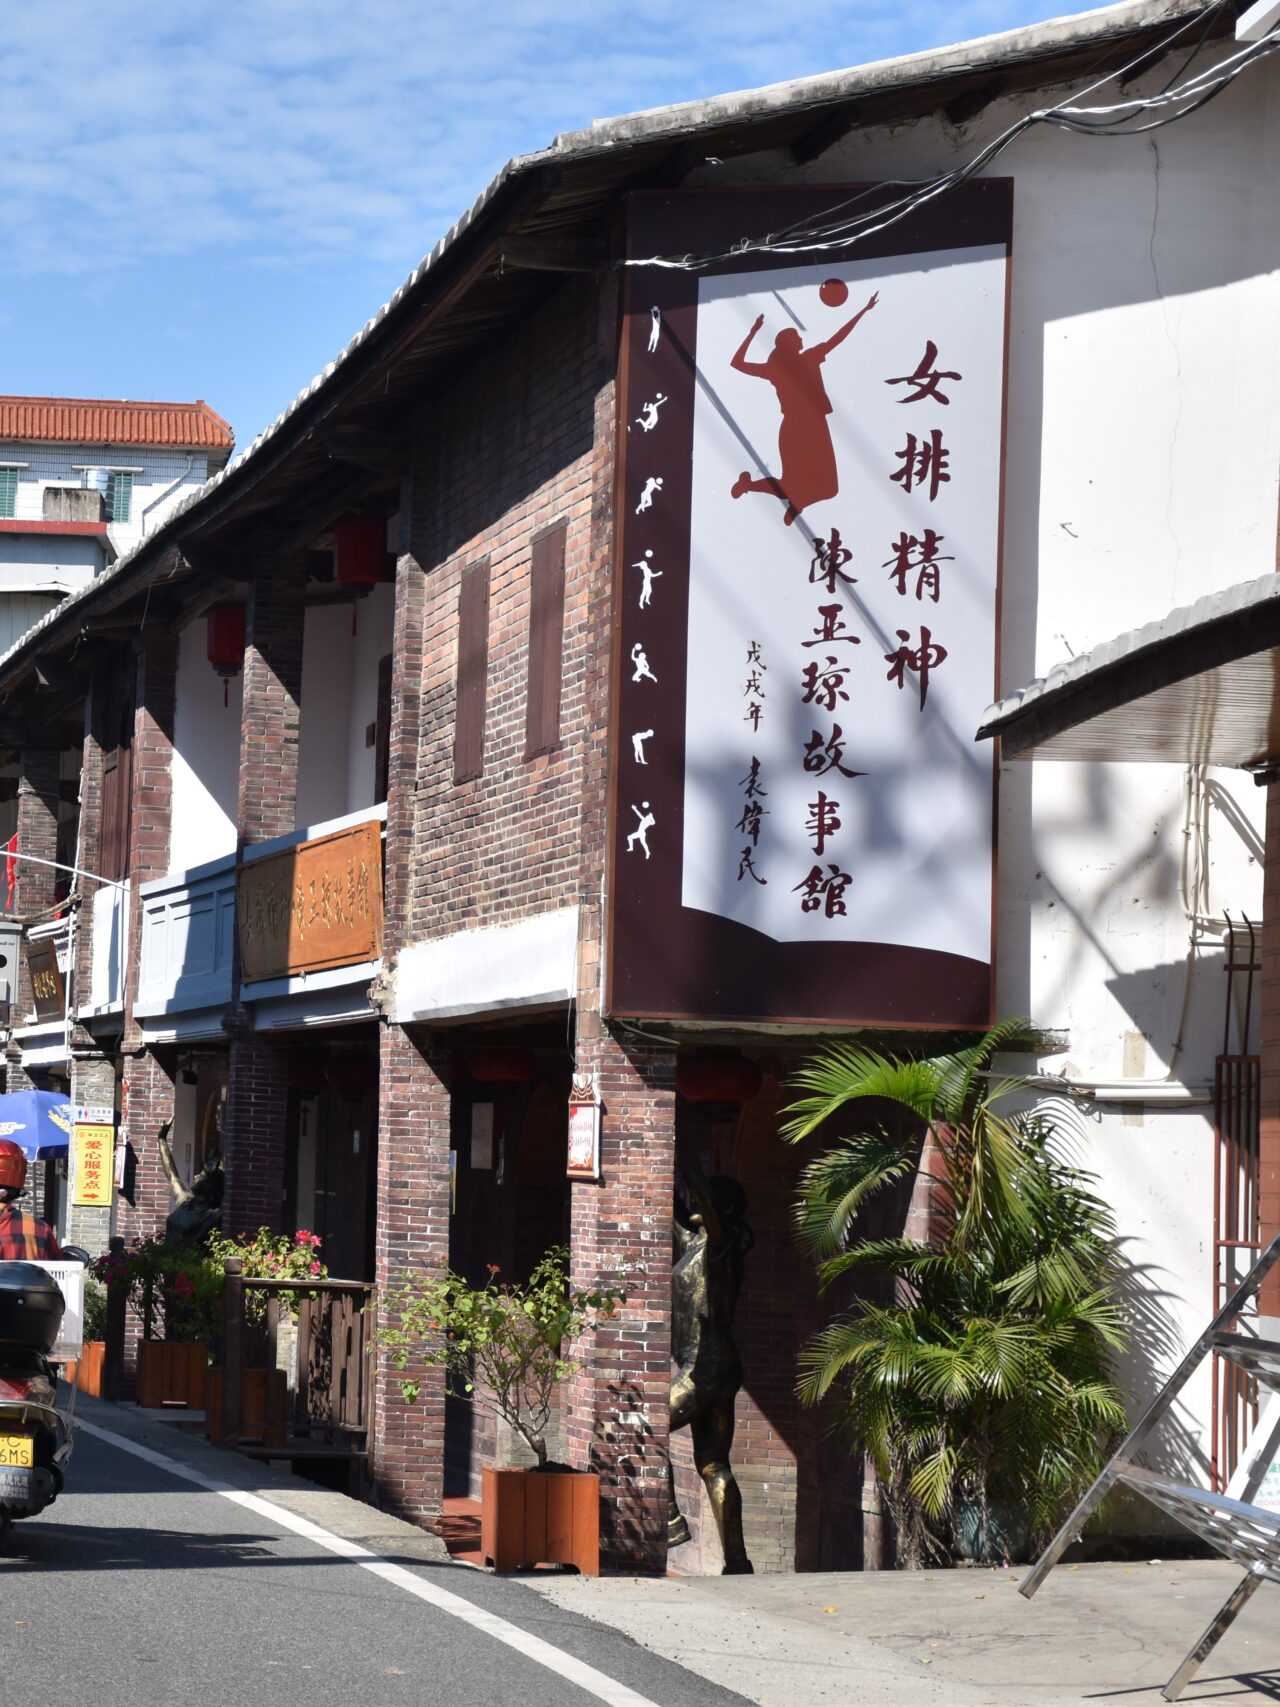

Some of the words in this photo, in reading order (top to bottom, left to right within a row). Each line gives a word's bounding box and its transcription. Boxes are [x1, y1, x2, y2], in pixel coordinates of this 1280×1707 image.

[883, 340, 962, 713] 女排精神
[743, 641, 767, 732] 戊戌年
[83, 1141, 103, 1190] 爱心服务点
